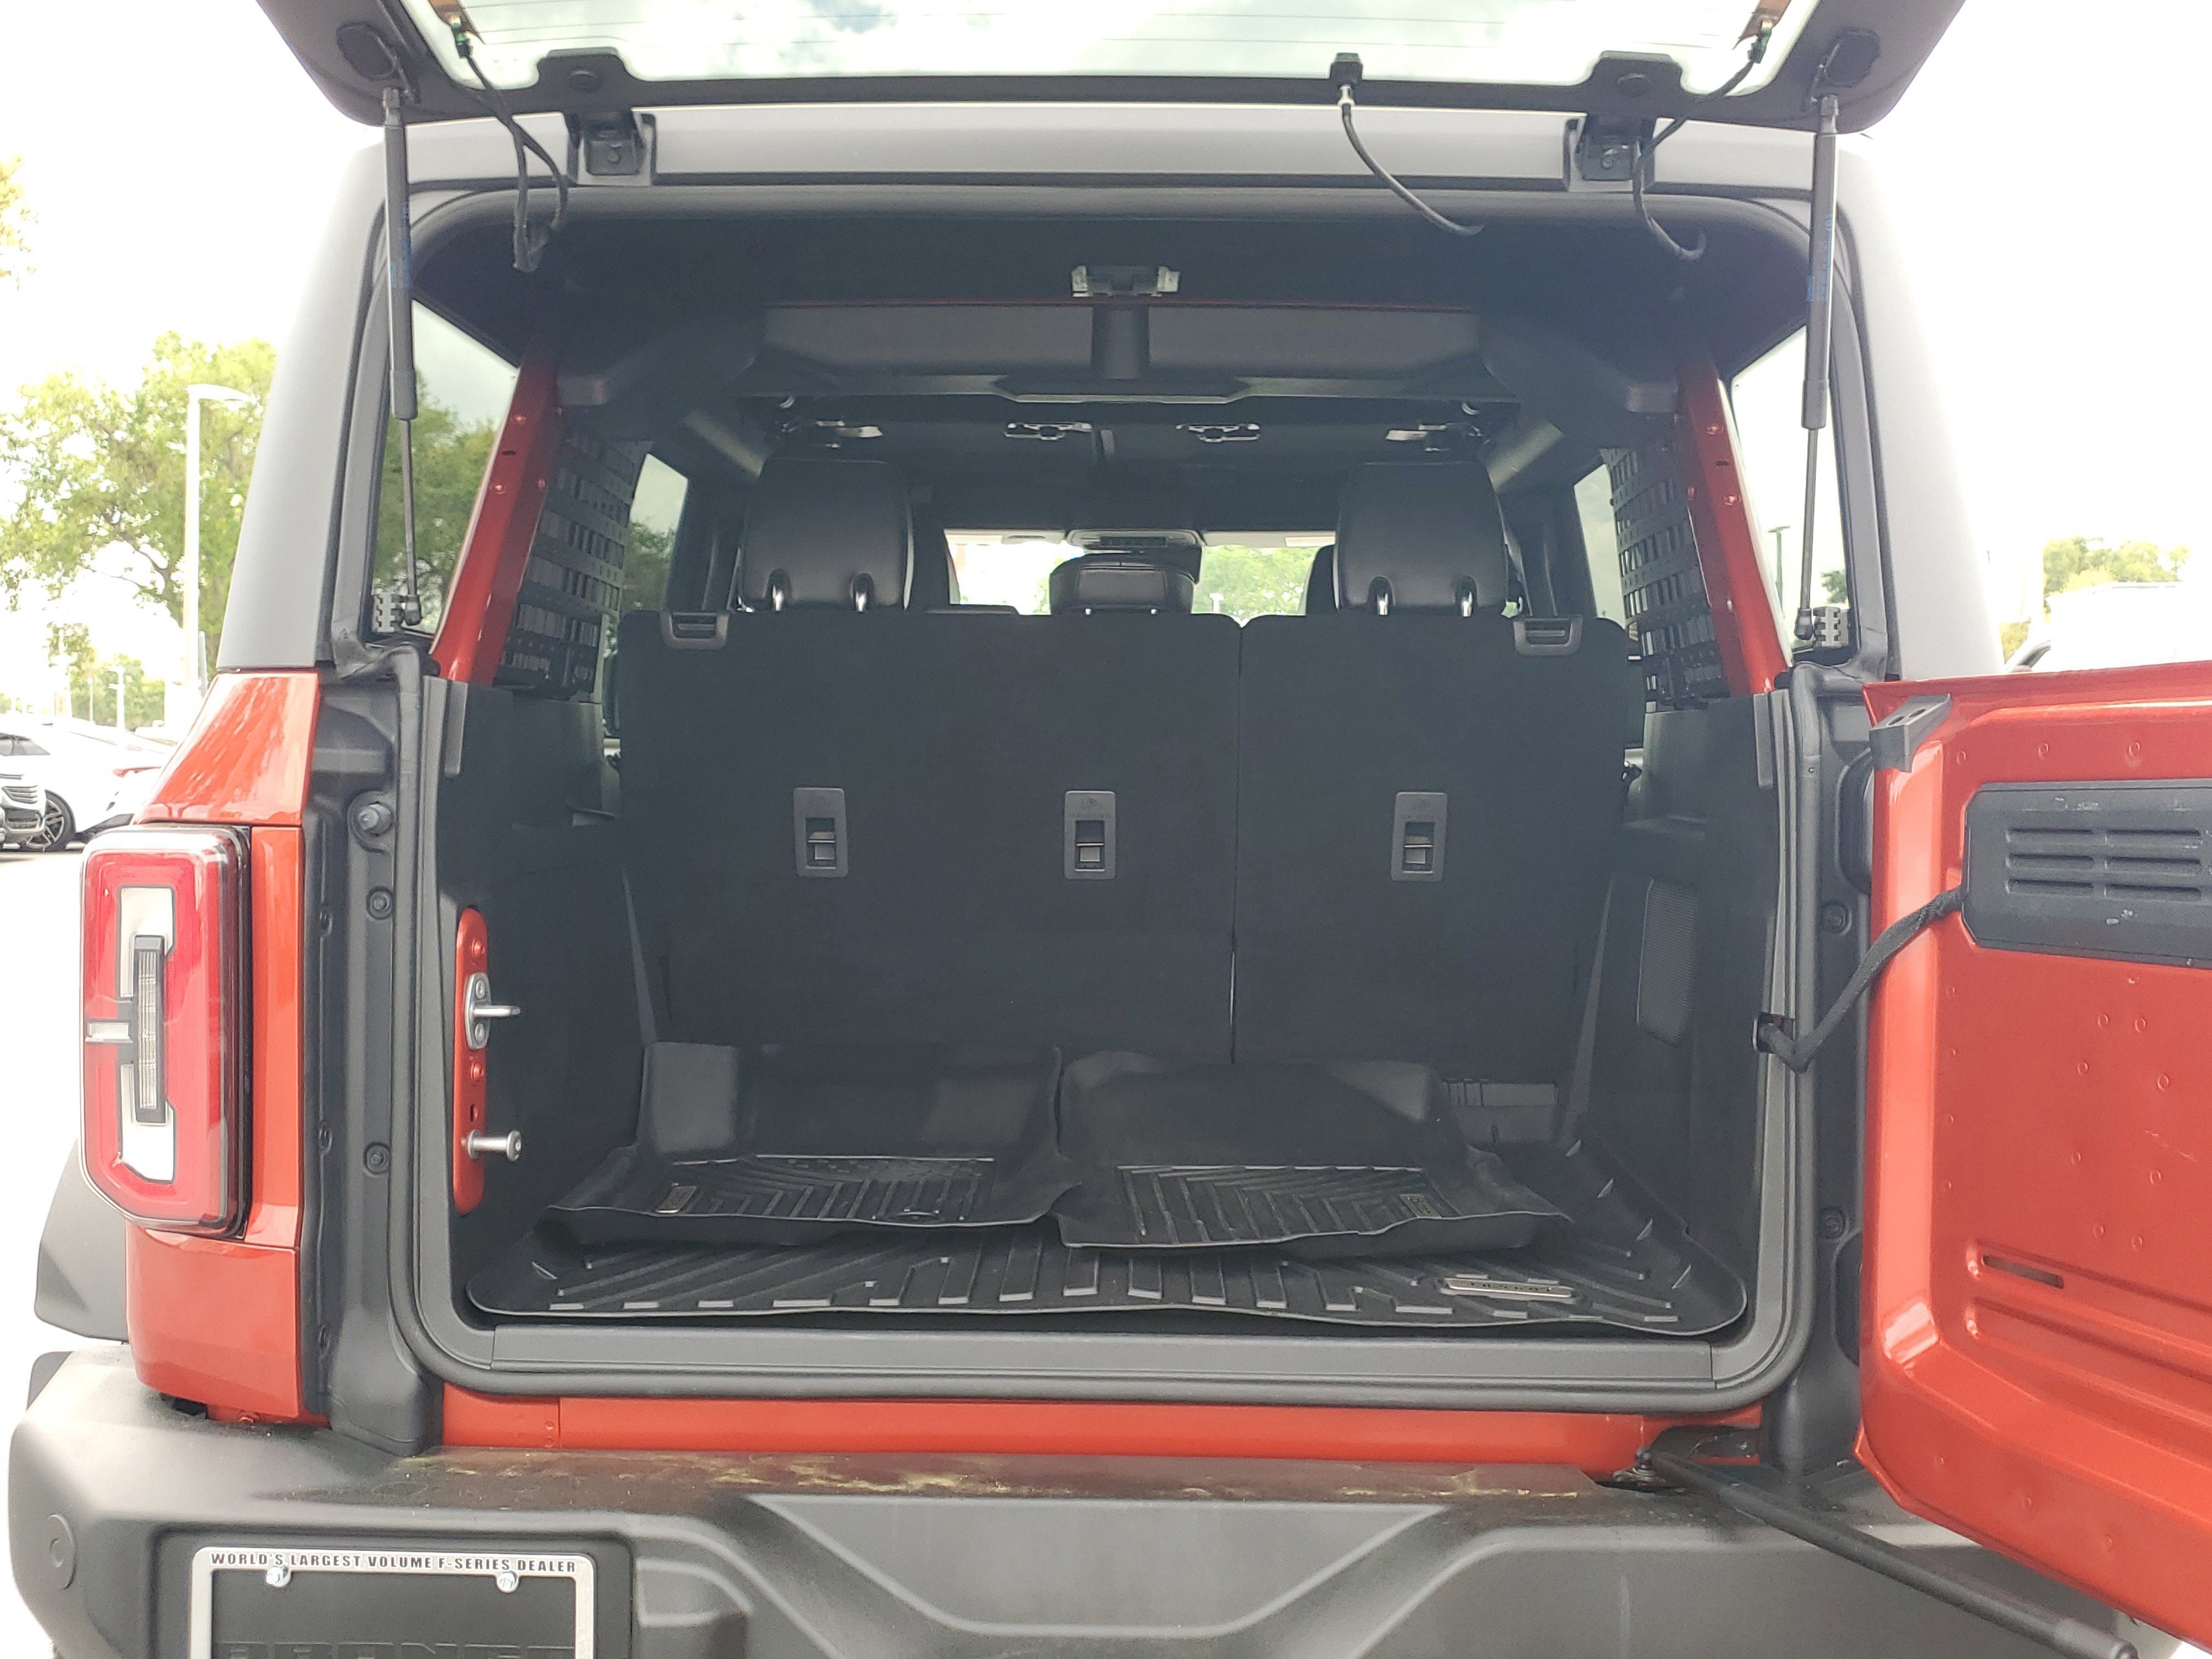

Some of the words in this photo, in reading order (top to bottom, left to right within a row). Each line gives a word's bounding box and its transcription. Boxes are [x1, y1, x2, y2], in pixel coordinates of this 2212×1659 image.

[211, 1553, 284, 1565] WORLD'S
[290, 1554, 361, 1567] LARGEST
[368, 1555, 431, 1568] VOLUME
[438, 1557, 510, 1570] F-SERIES
[517, 1560, 575, 1572] DEALER
